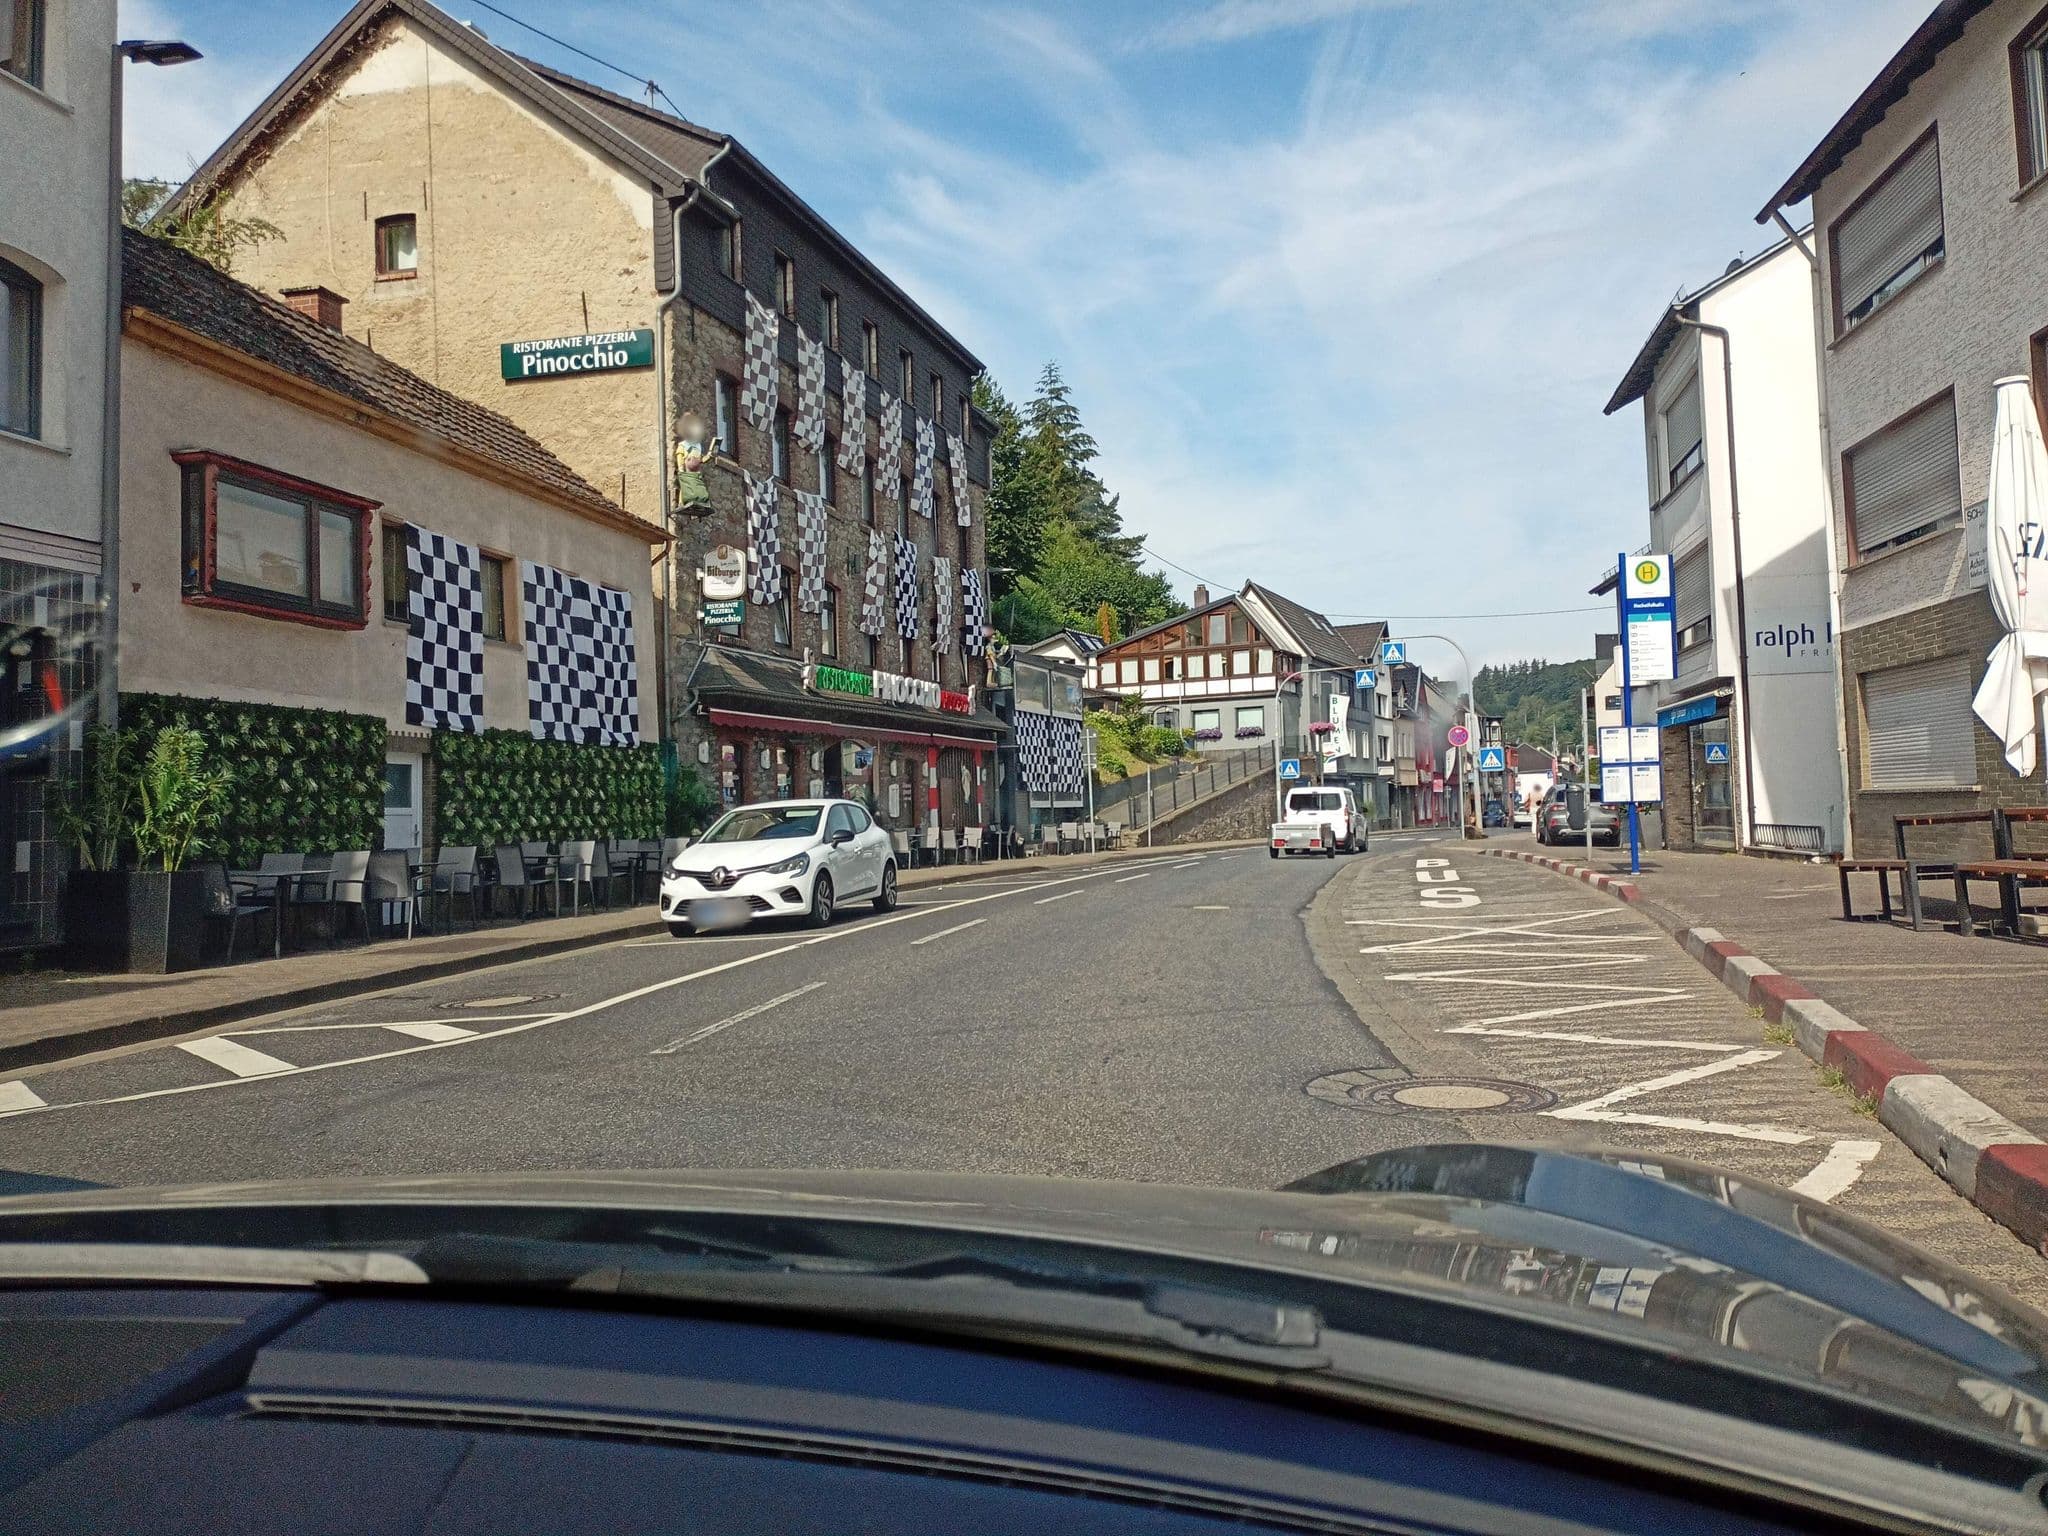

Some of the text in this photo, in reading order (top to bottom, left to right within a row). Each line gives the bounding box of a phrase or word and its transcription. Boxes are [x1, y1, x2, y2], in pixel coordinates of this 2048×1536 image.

[513, 331, 637, 354] RISTORANTE PIZZERIA
[522, 345, 628, 375] Pinocchio
[707, 565, 740, 578] Bitburger
[1642, 566, 1653, 579] H
[706, 602, 738, 610] RISTORANTE
[704, 614, 741, 625] Pinocchio
[1756, 623, 1814, 657] ralph
[873, 670, 941, 709] PINOCCHIO
[1416, 858, 1482, 909] BUS
